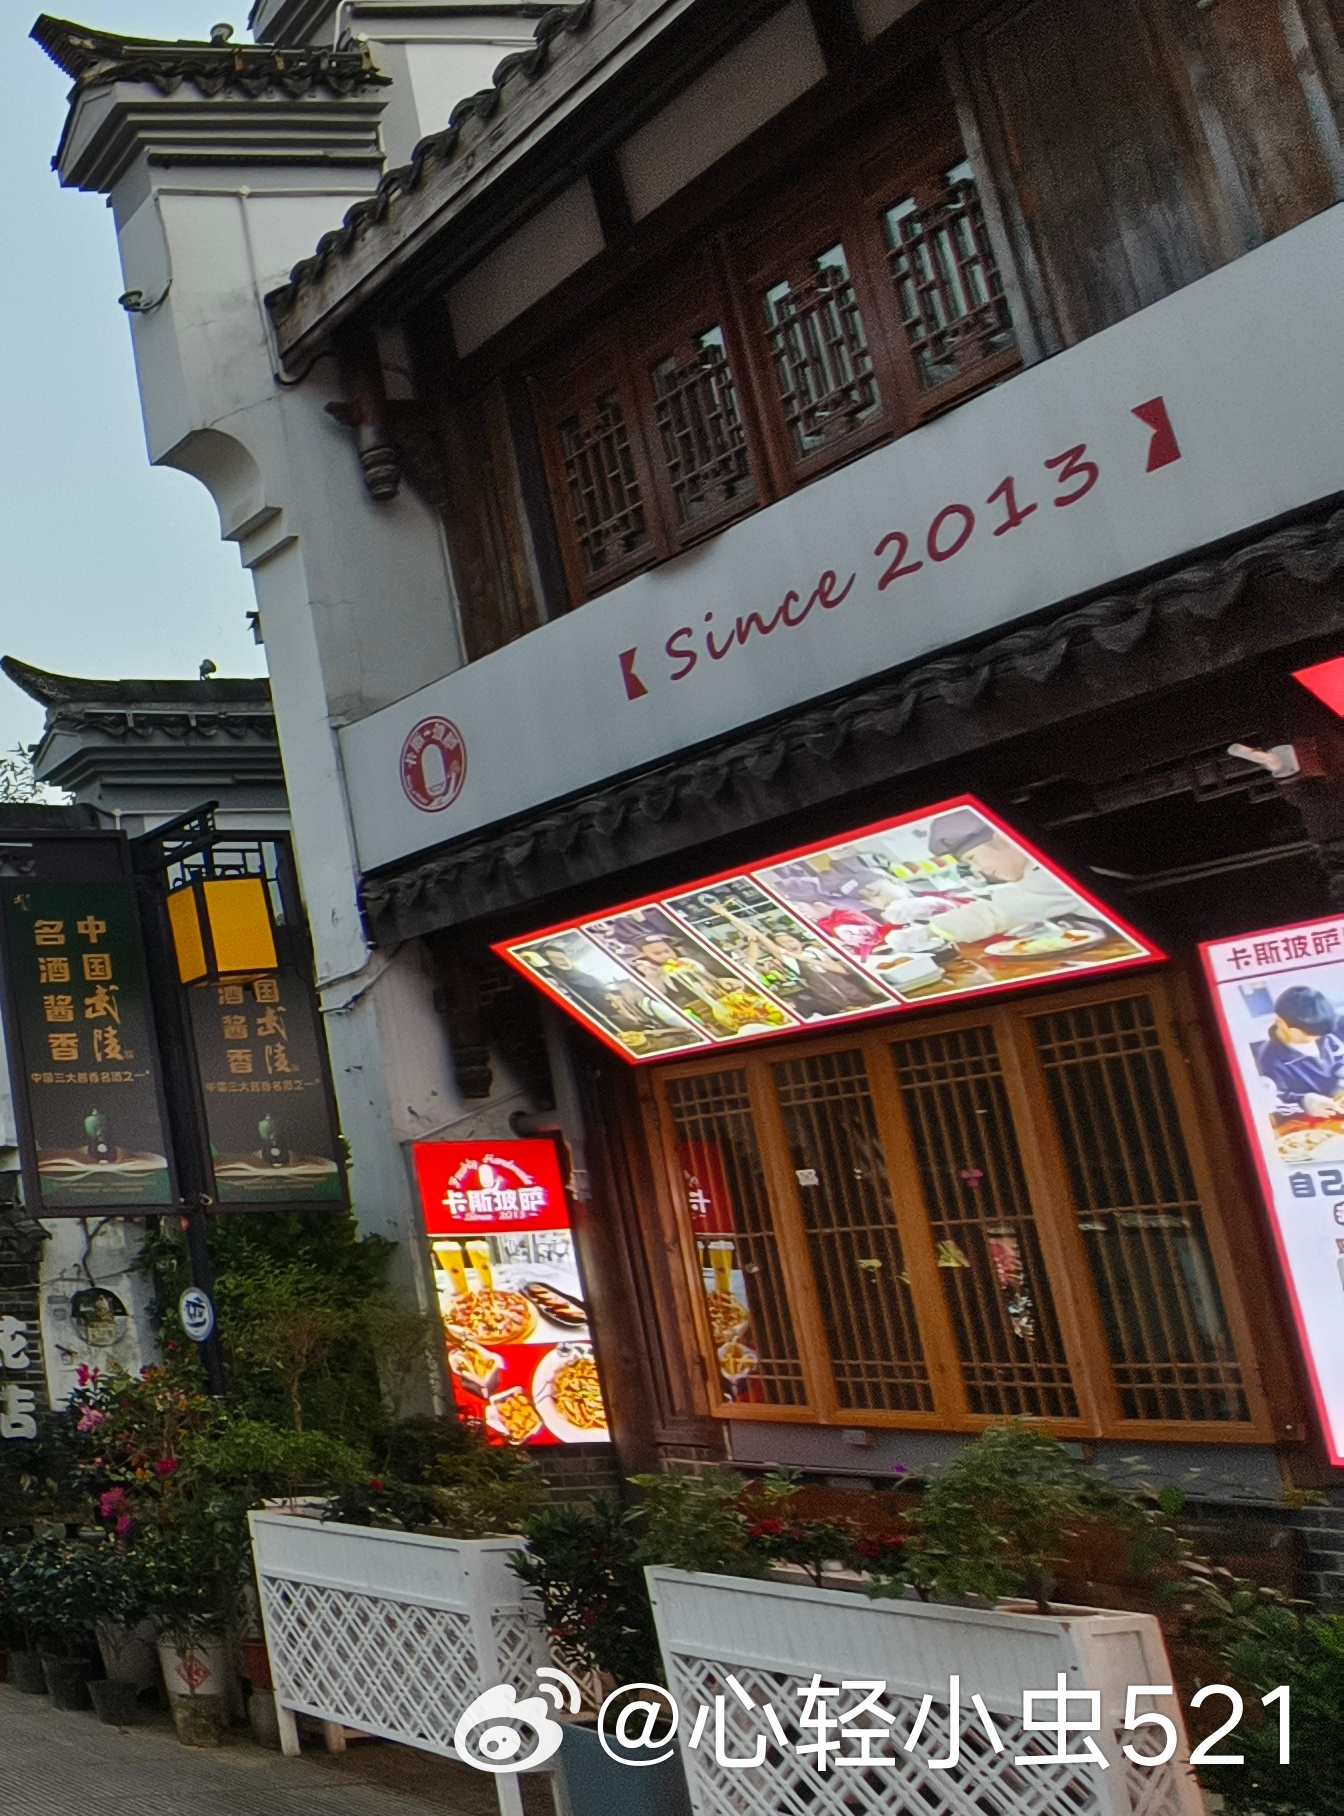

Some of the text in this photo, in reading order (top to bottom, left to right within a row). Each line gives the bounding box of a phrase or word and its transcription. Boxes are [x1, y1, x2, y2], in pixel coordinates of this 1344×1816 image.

[665, 443, 1099, 681] Since 2013
[34, 919, 79, 1062] 名酒酱香
[76, 914, 124, 1063] 中国武陵
[218, 984, 254, 1074] 酒酱香
[253, 978, 292, 1075] 国武陵
